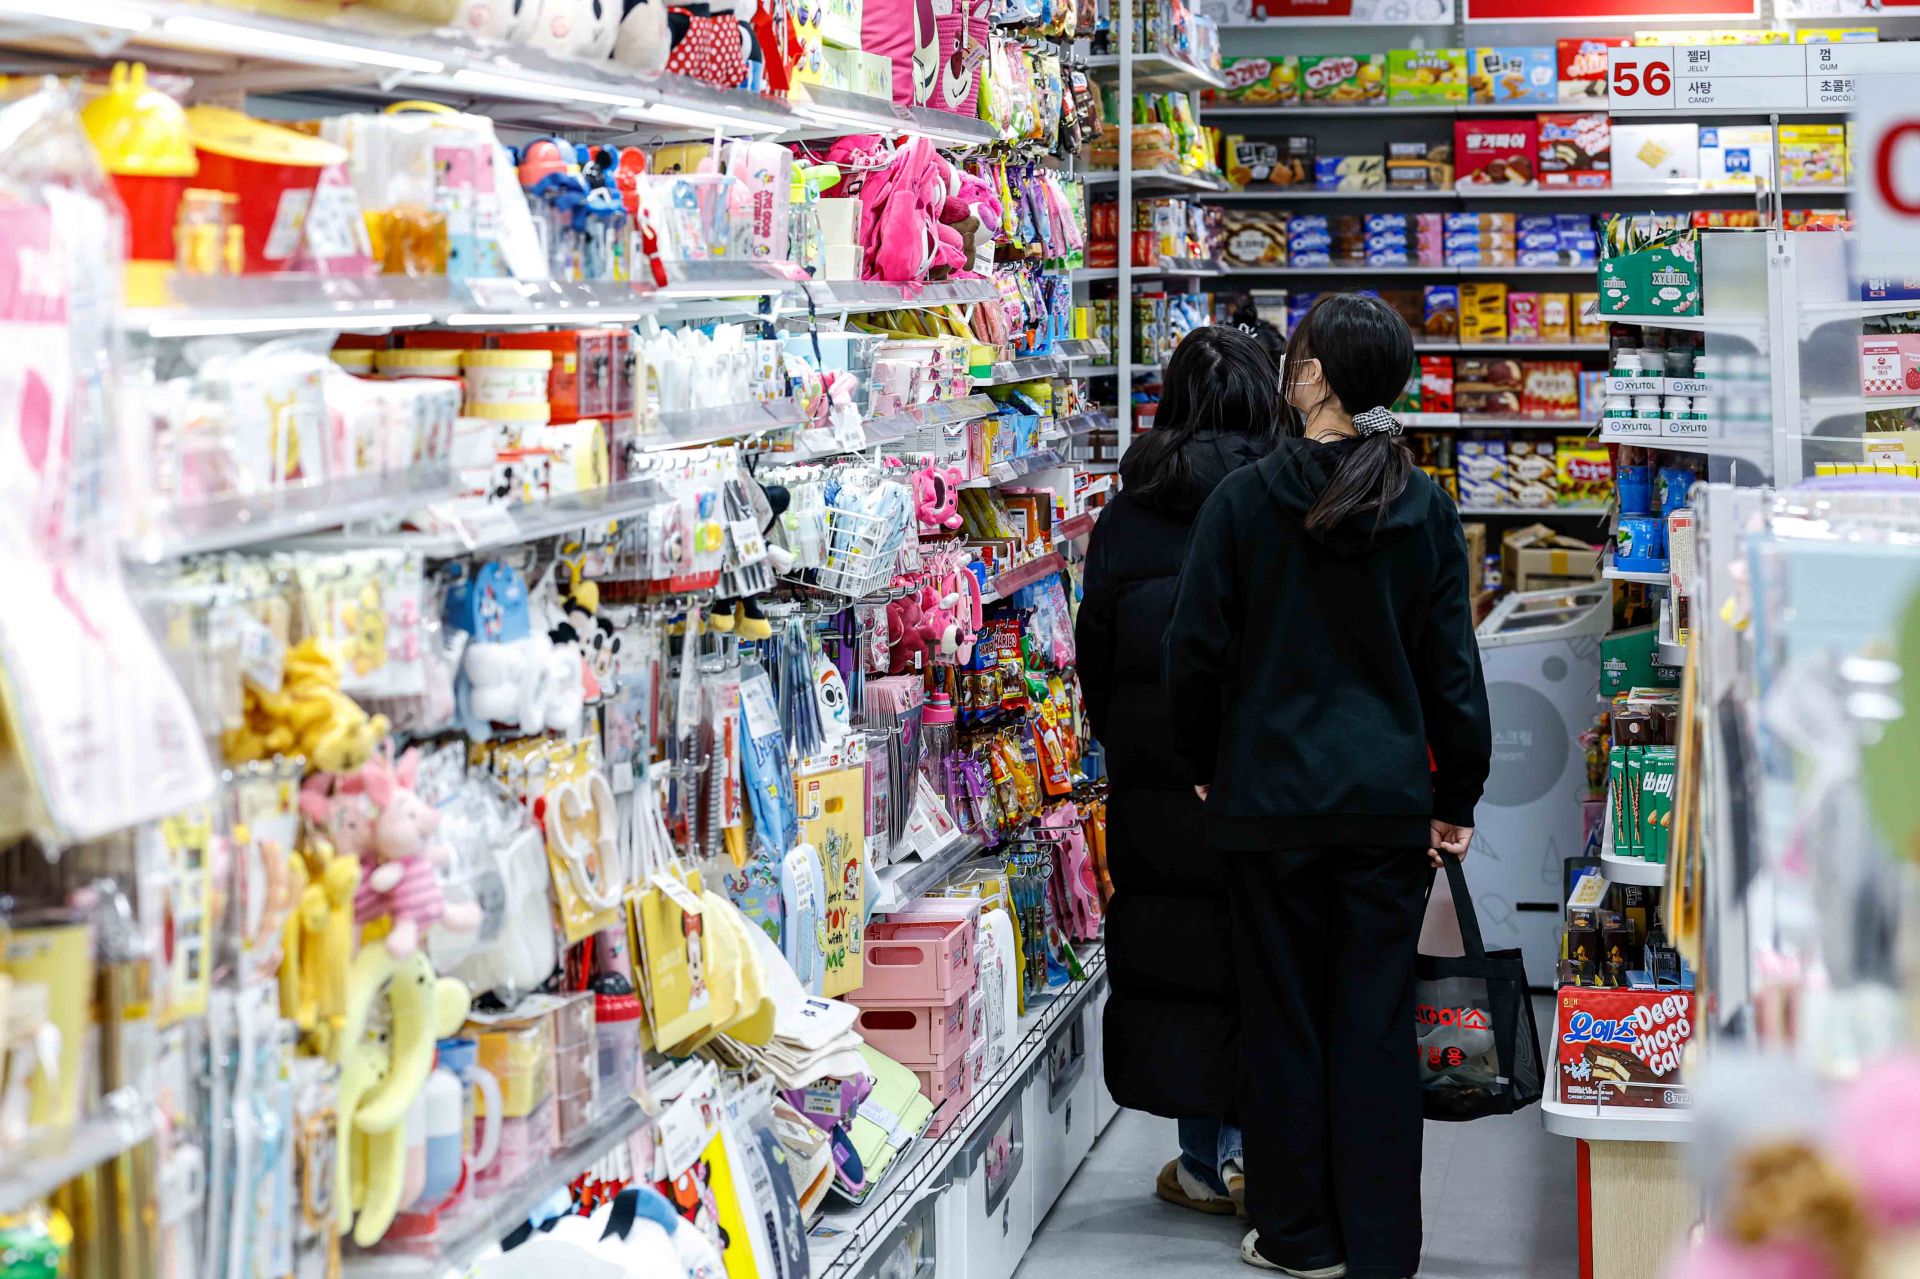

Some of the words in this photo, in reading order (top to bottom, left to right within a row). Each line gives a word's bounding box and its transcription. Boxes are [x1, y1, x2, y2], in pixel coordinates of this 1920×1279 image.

[1687, 50, 1711, 63] 젤리
[1820, 49, 1831, 61] 껌
[1820, 63, 1838, 71] GUM
[1613, 61, 1671, 97] 56
[1688, 81, 1711, 94] 사탕
[1688, 96, 1714, 104] CANDY
[1652, 272, 1690, 286] XYLITOL
[1625, 382, 1655, 390] XYLITOL
[1680, 424, 1707, 432] XYLITO
[826, 907, 848, 933] TOY
[828, 931, 844, 946] with
[1633, 995, 1689, 1032] Deep
[1563, 1010, 1638, 1044] 오예스
